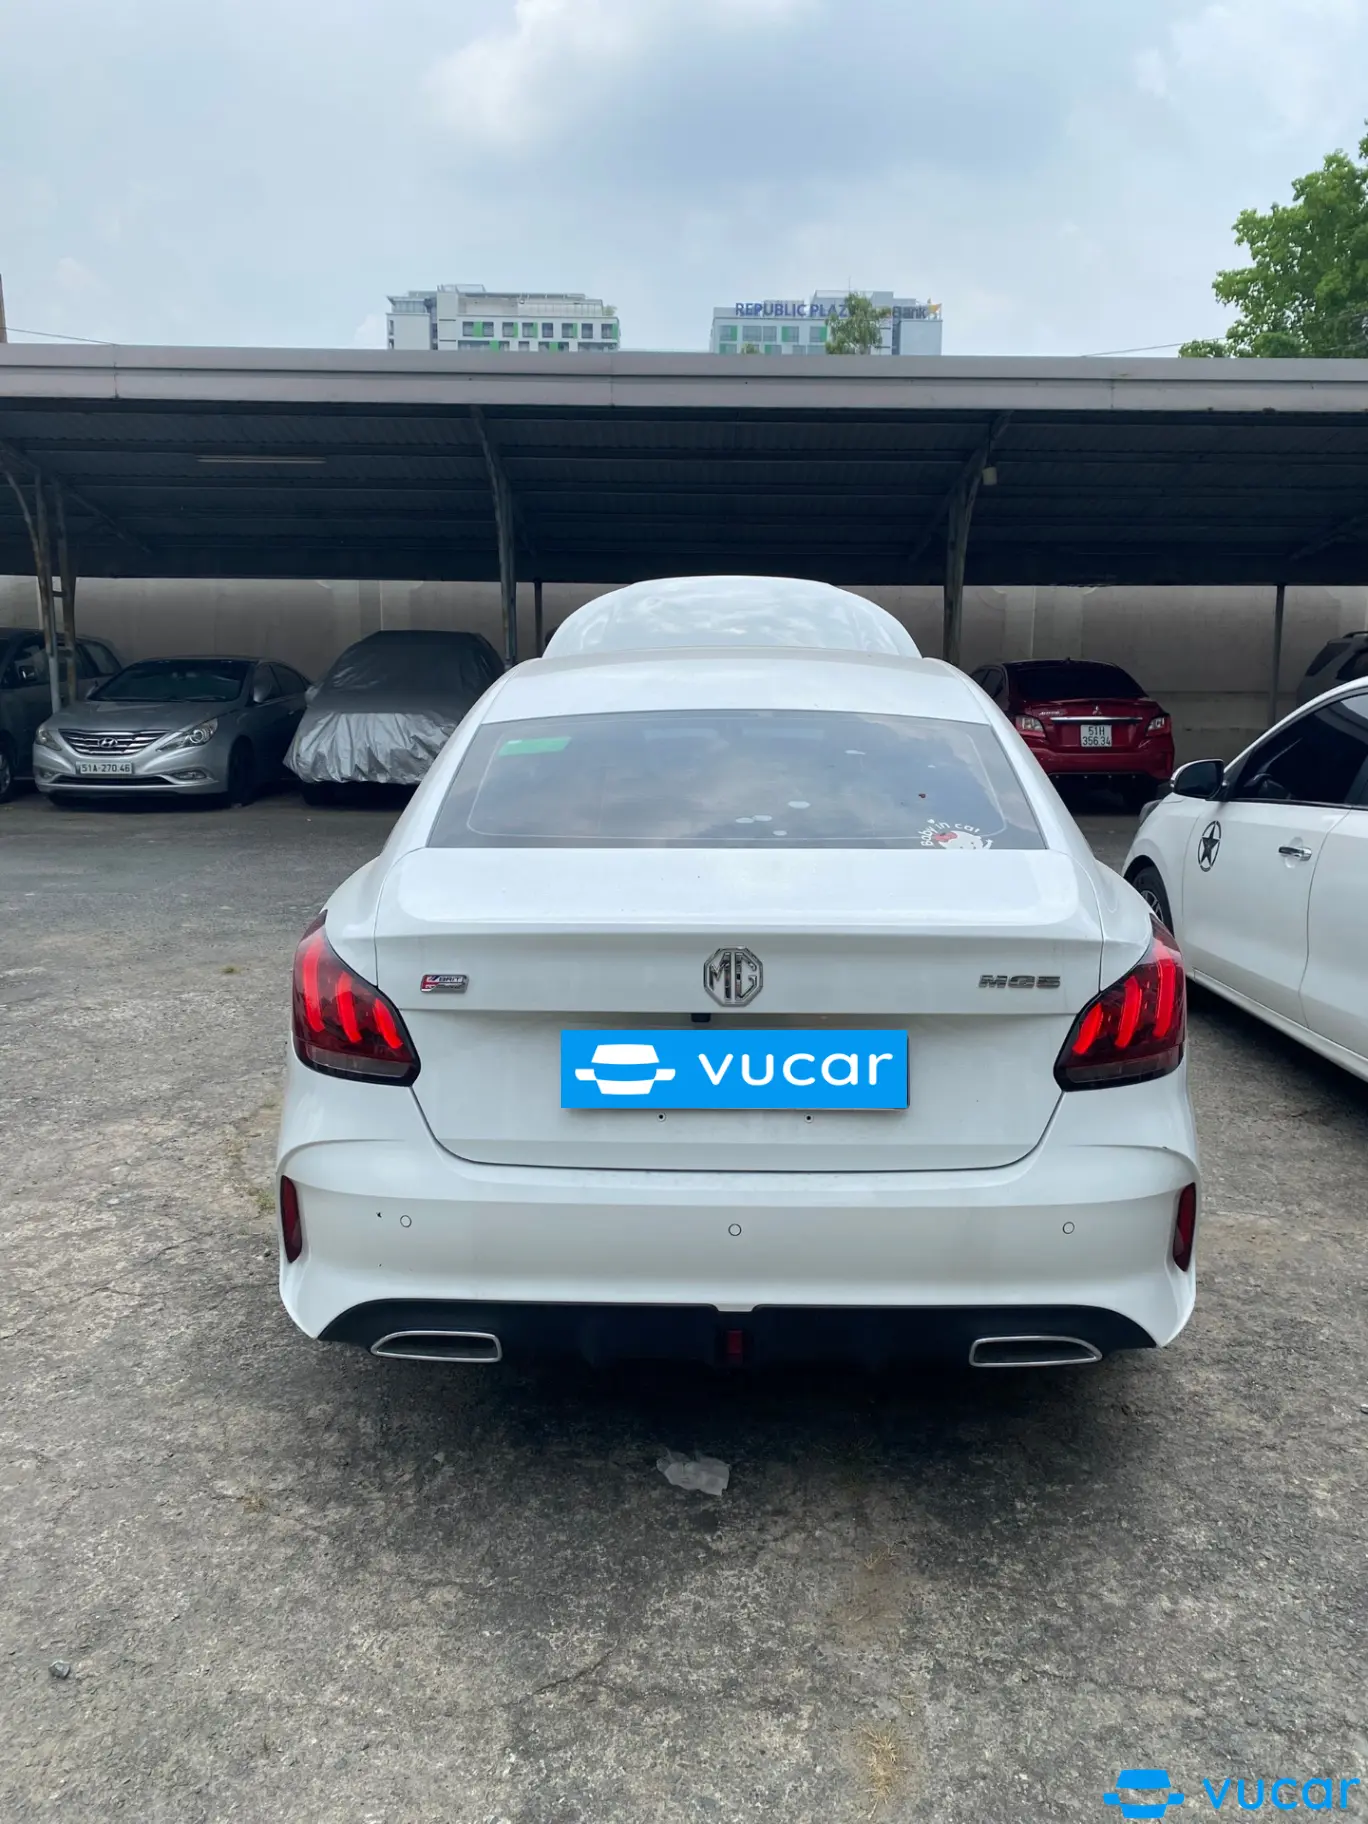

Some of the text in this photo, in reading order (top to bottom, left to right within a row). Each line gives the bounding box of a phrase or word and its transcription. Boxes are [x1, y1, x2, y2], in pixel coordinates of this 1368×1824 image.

[735, 302, 850, 317] REPUBLIC PLAZ
[1088, 727, 1105, 736] 51H
[1082, 736, 1111, 746] 356.34
[955, 823, 980, 833] car
[707, 950, 760, 1002] MG
[978, 974, 1061, 989] MG5
